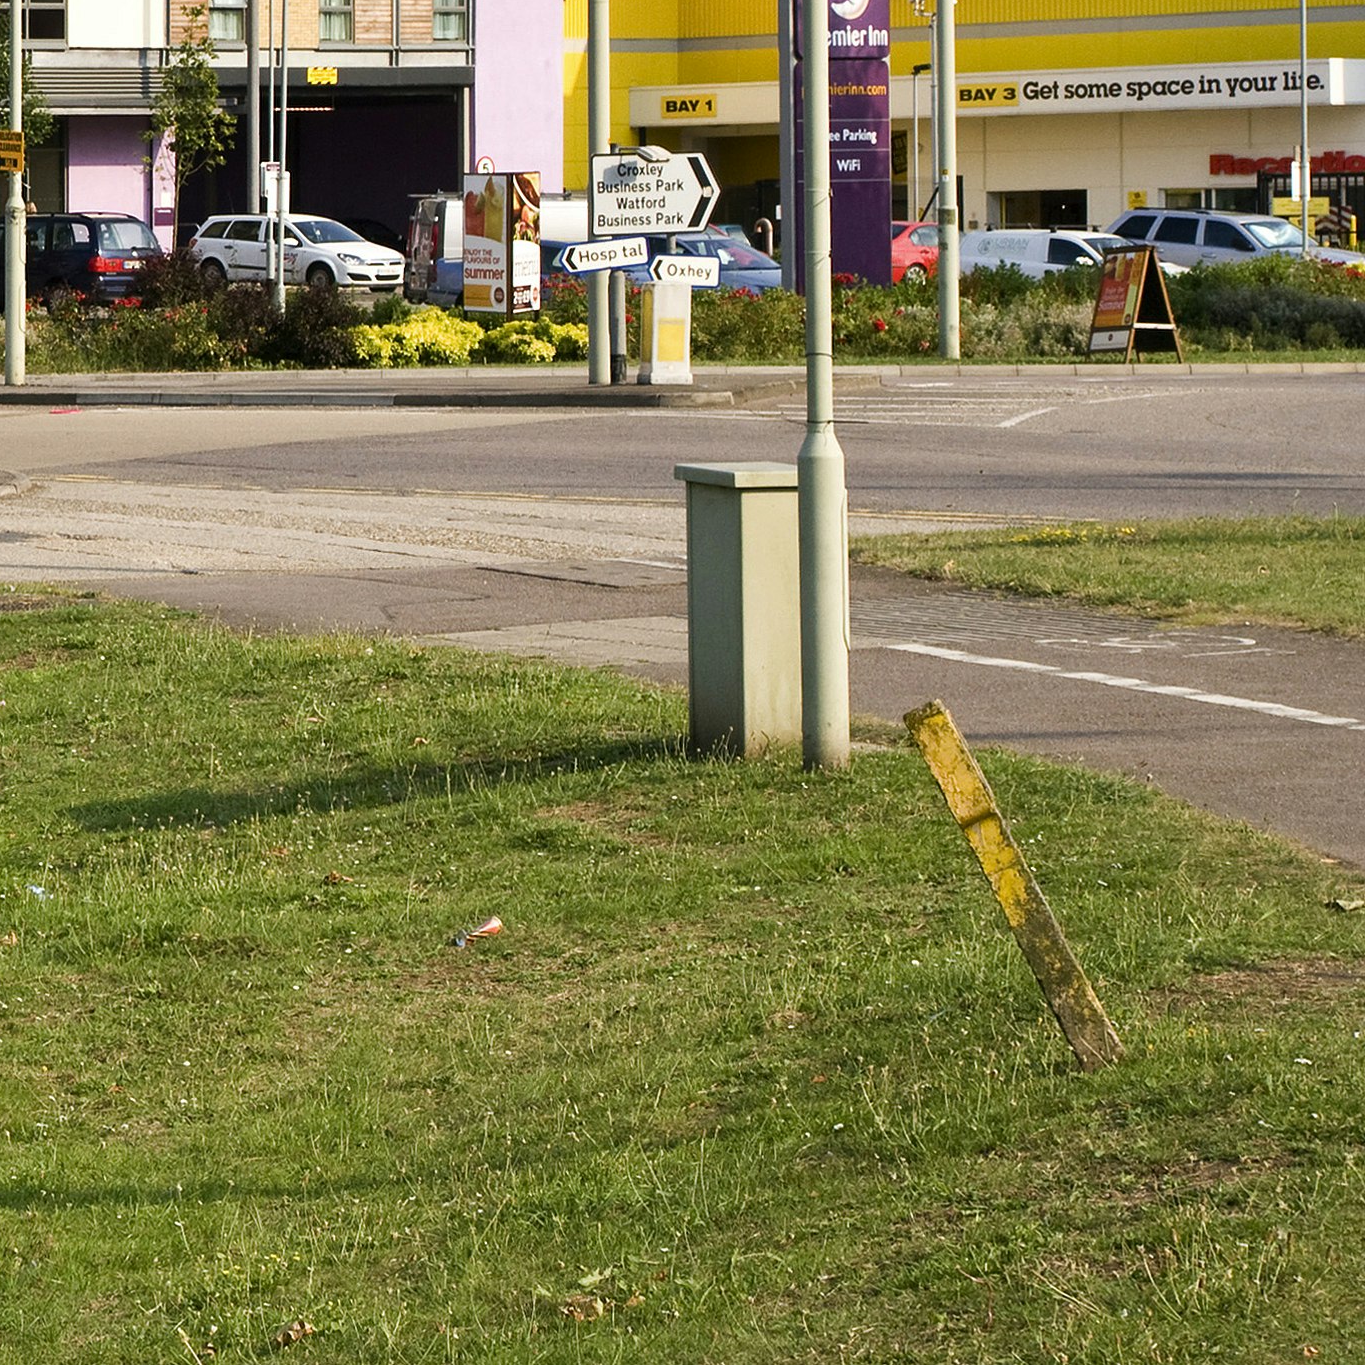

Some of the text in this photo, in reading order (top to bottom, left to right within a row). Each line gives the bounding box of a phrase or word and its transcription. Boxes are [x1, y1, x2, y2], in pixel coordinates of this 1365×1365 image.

[827, 25, 888, 47] emier Inn
[1023, 71, 1324, 101] Get some space in your lie.
[959, 88, 1016, 102] BAY 3
[665, 99, 712, 113] BAY 1
[843, 128, 877, 145] Parking
[617, 163, 663, 177] Croxley
[836, 159, 861, 172] WiFi
[597, 179, 684, 194] Business Park
[616, 196, 666, 209] Watford
[597, 212, 684, 227] Business Park
[579, 244, 644, 263] Hosptal
[465, 268, 505, 280] summer
[667, 263, 712, 279] Oxhey
